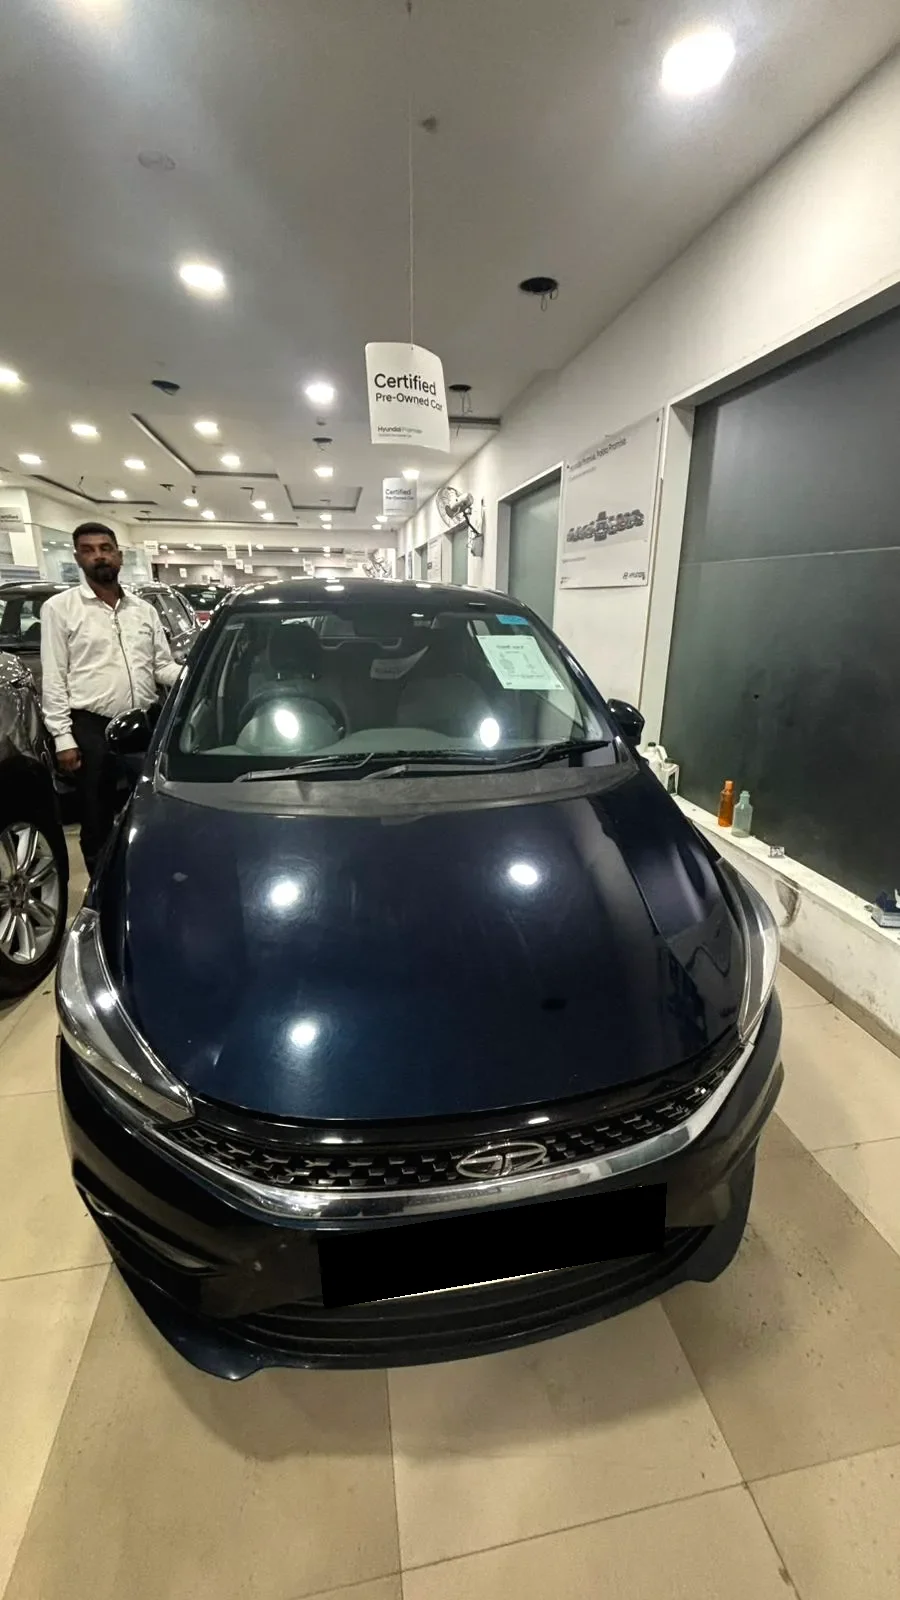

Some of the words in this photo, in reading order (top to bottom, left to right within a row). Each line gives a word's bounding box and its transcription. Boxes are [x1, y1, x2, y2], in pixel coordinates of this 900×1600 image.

[374, 373, 437, 396] Certified
[375, 392, 430, 407] Pre-Owned
[430, 399, 443, 412] Car
[377, 425, 402, 433] Hyundai
